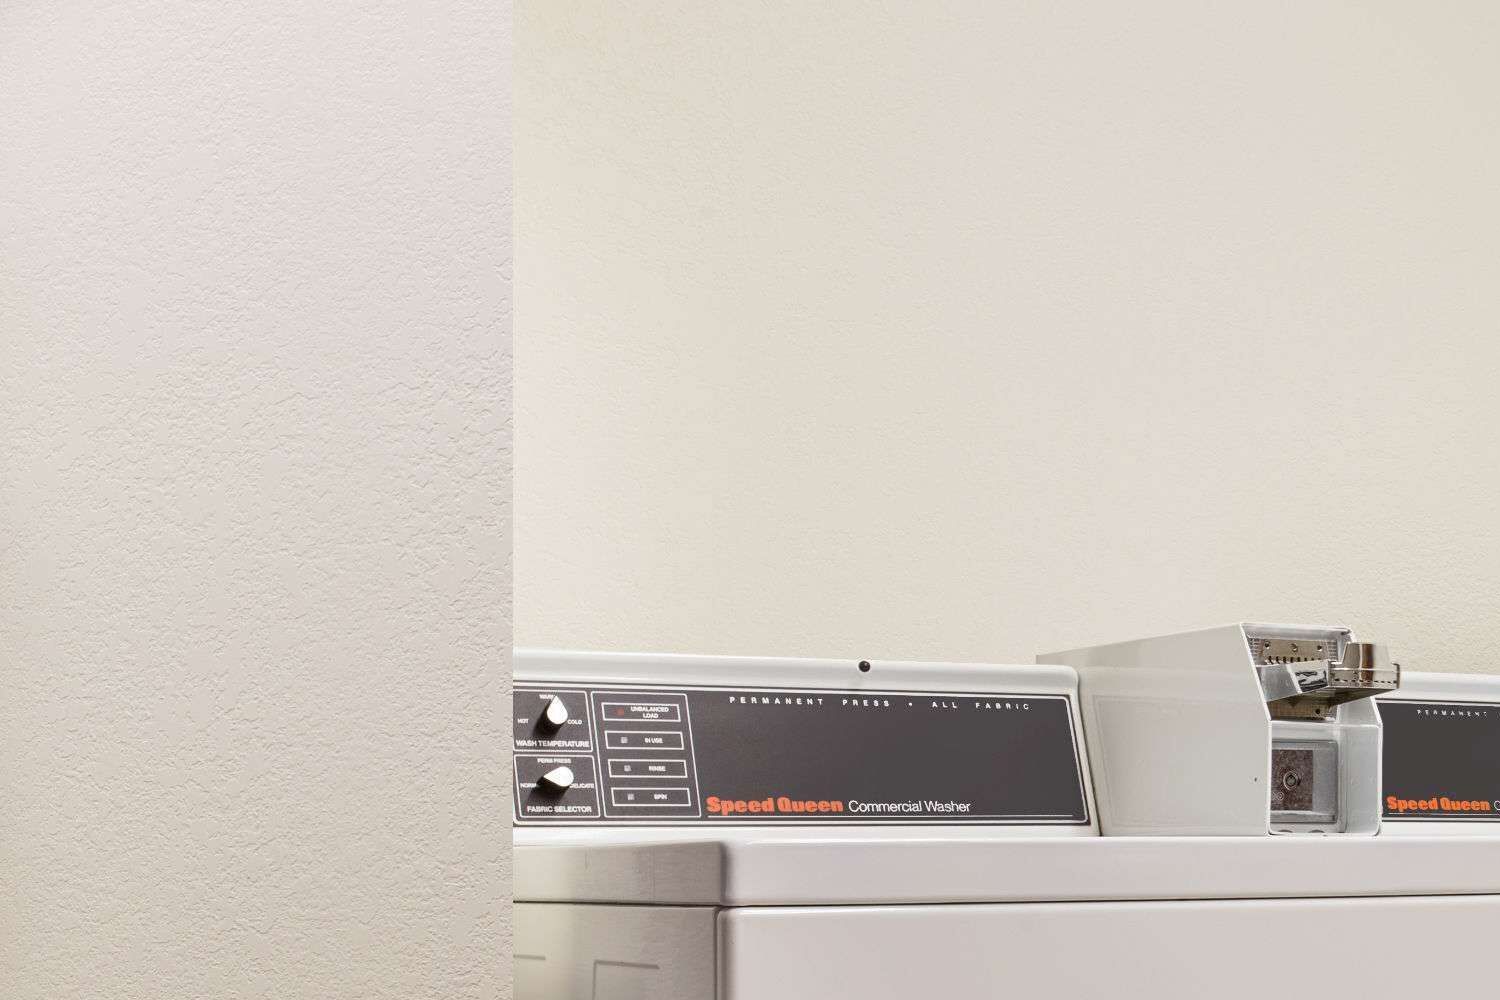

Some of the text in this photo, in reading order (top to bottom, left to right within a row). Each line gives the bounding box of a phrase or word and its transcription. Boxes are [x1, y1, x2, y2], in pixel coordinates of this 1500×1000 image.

[729, 696, 1029, 710] PERMANENT PRESS ALL FABRIC
[538, 740, 590, 748] TEMPERATURE
[526, 805, 592, 813] FABRIC SELECTOR
[706, 796, 972, 815] Speed Queen Commercial Washer
[1386, 796, 1439, 812] Speed
[1440, 797, 1491, 811] Queen
